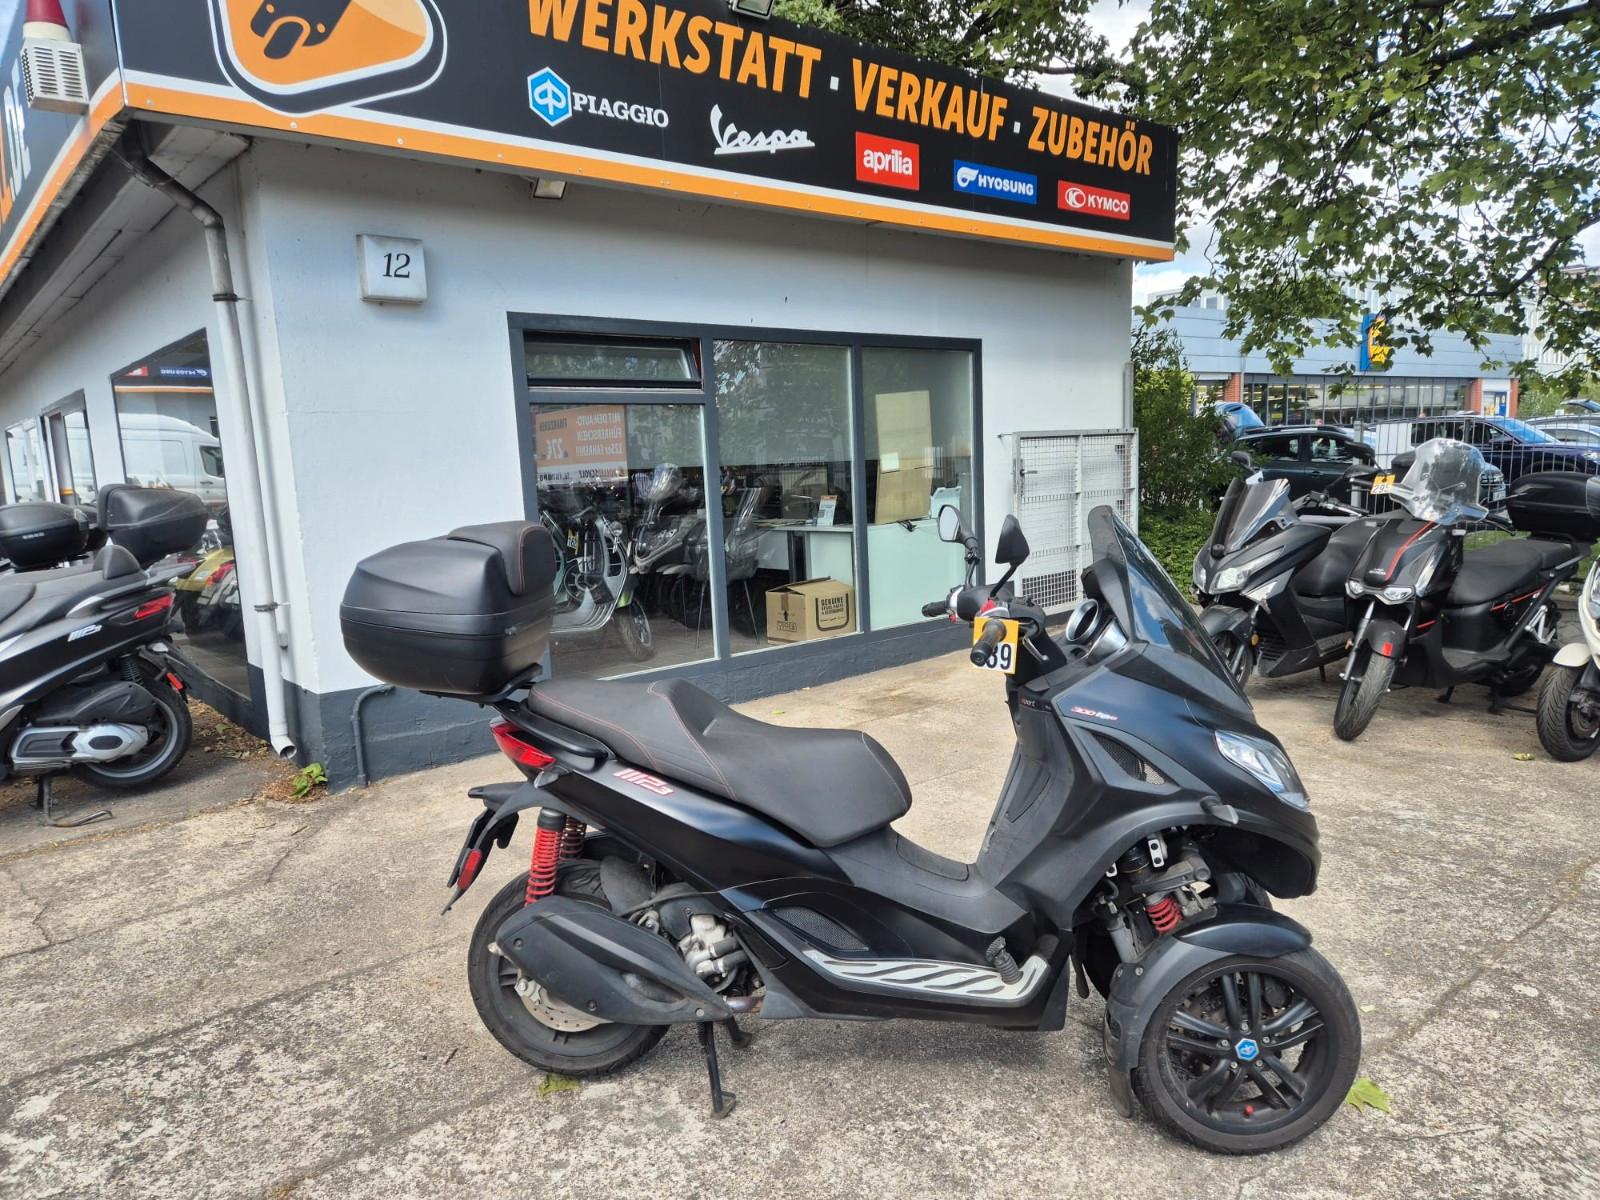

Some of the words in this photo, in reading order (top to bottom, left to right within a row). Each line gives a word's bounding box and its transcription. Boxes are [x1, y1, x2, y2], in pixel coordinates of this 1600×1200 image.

[528, 0, 822, 99] WERKSTATT
[852, 58, 1008, 142] VERKAUF
[1028, 106, 1153, 176] ZUBEHÖR
[572, 91, 670, 128] PIAGGIO
[710, 103, 816, 155] Vespa
[863, 147, 913, 177] aprilia
[977, 174, 1035, 197] HYOSUNG
[1087, 192, 1130, 215] KYMCO
[382, 252, 411, 278] 12
